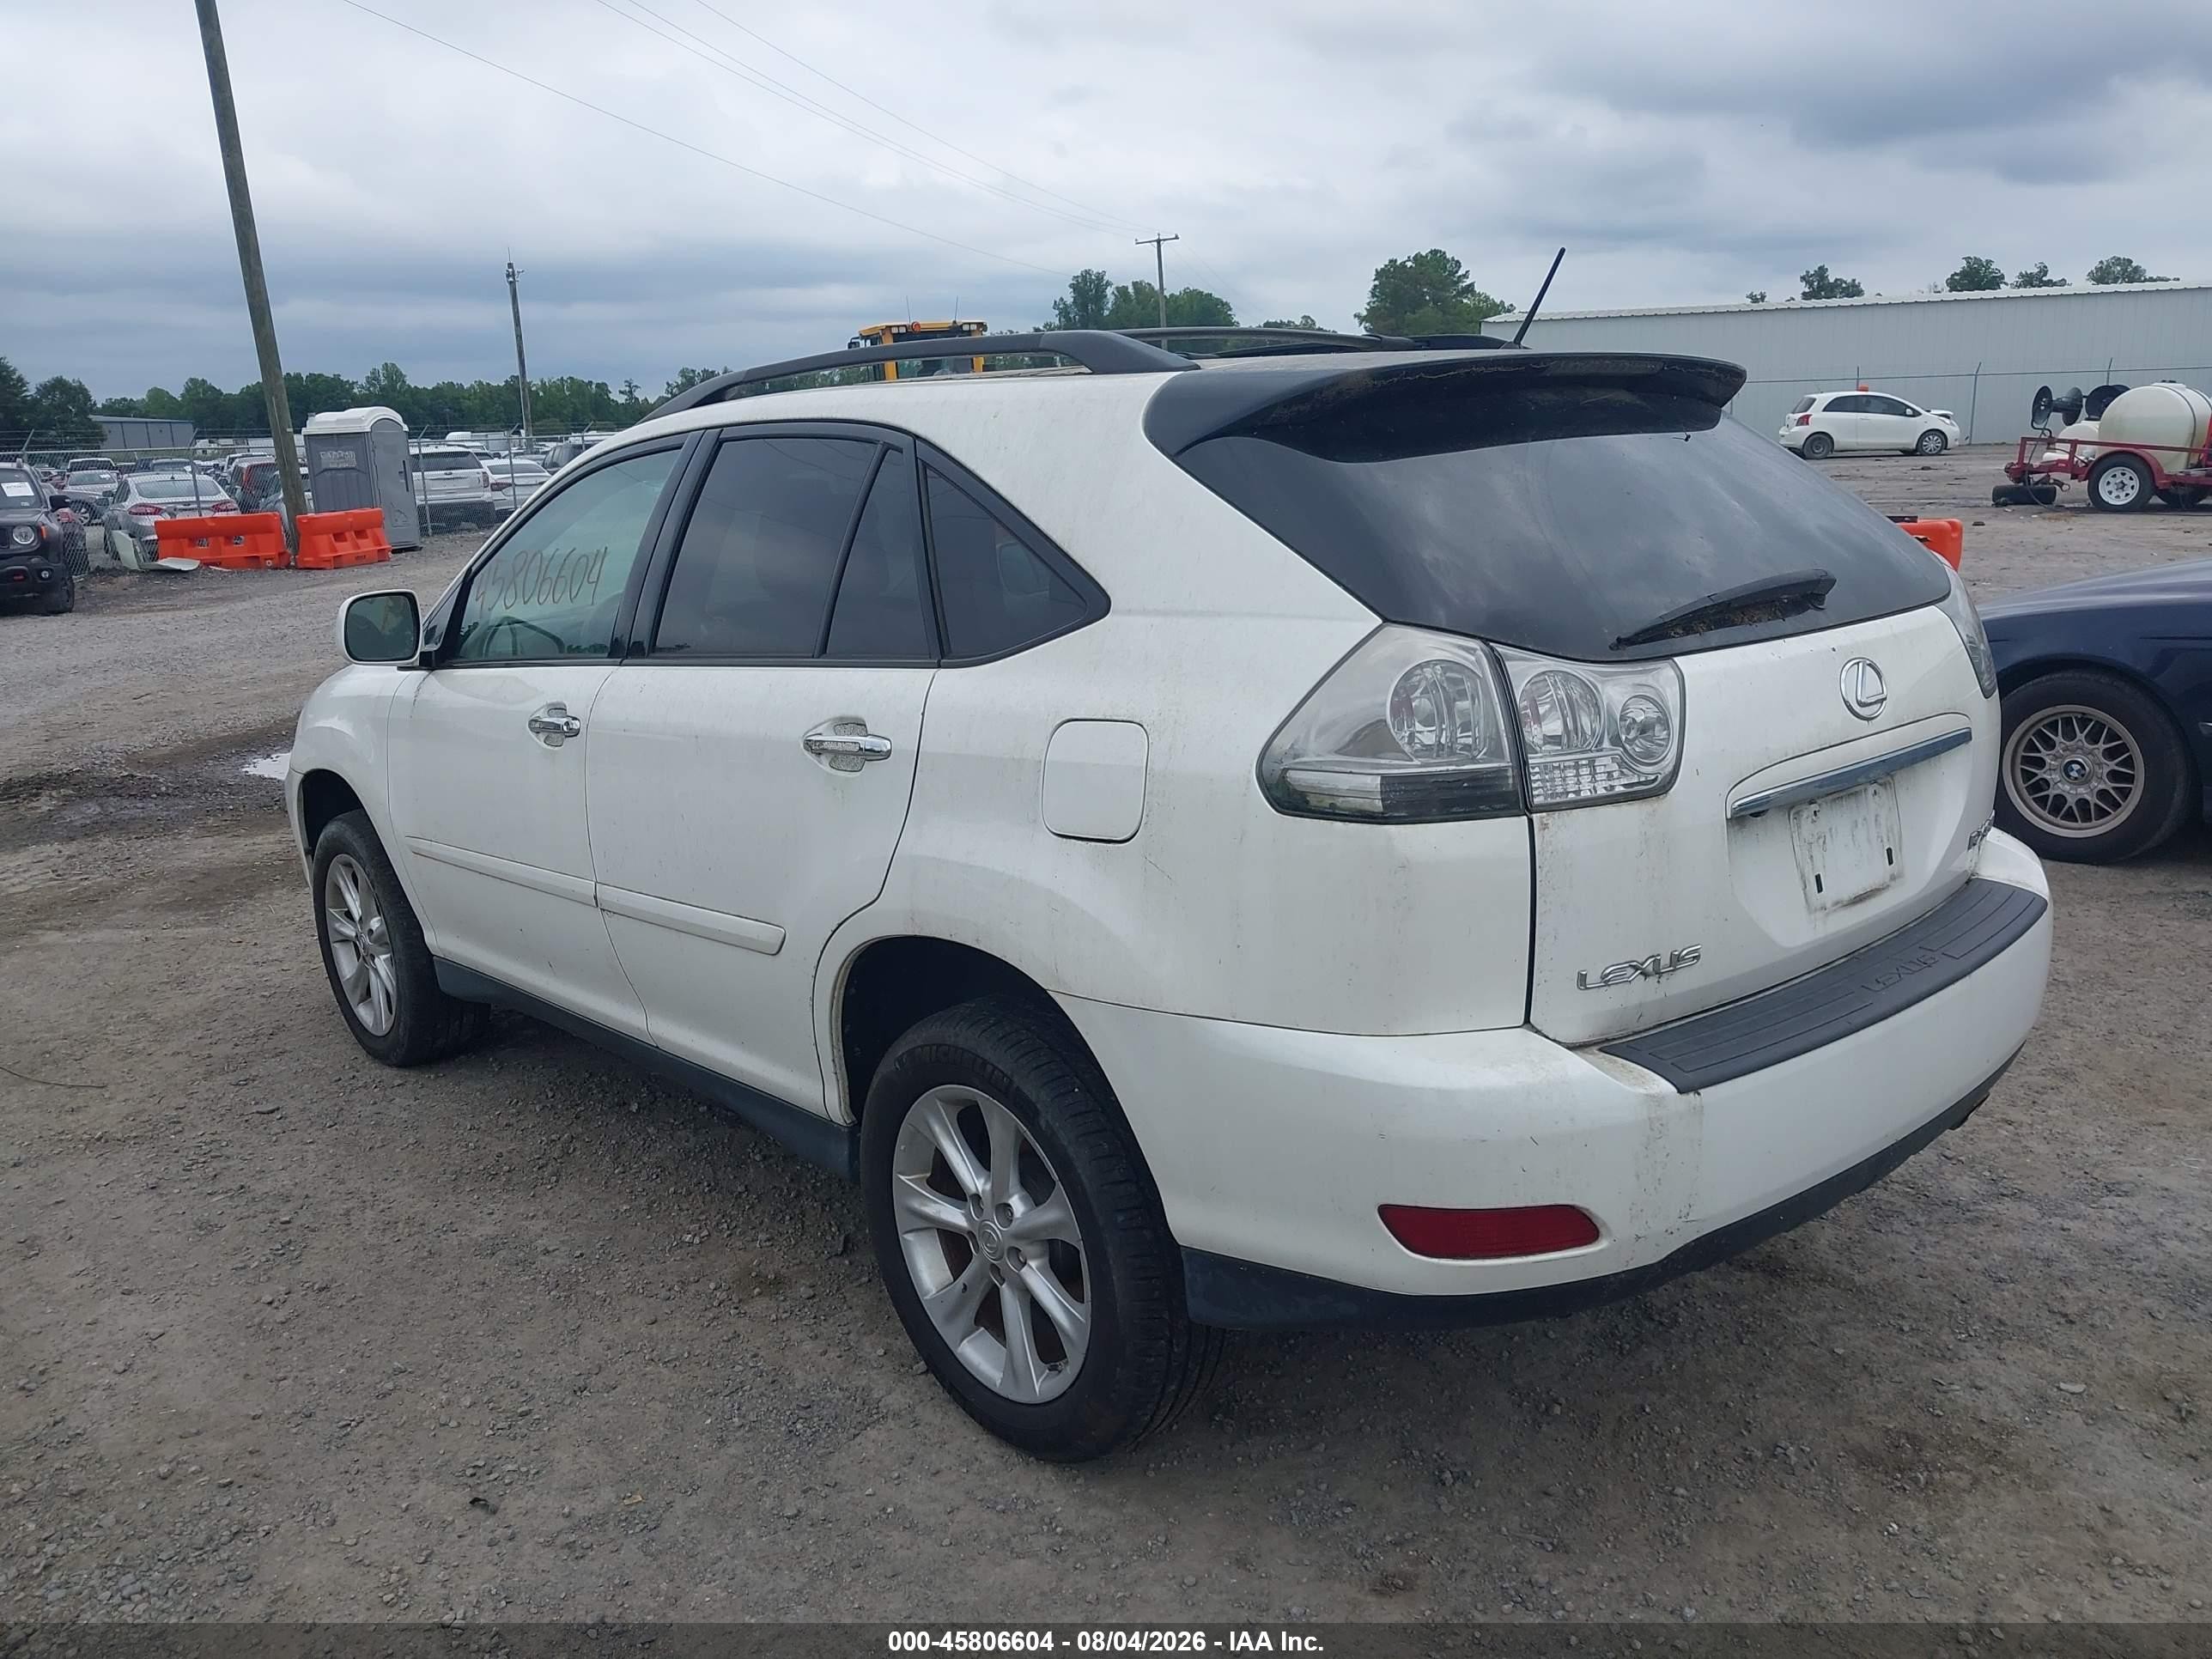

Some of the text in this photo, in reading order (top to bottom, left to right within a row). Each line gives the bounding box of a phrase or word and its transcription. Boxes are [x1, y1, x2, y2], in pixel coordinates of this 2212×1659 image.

[475, 546, 608, 616] 45806604
[1577, 944, 1702, 990] LEXUS
[1861, 955, 1940, 993] LEXUS
